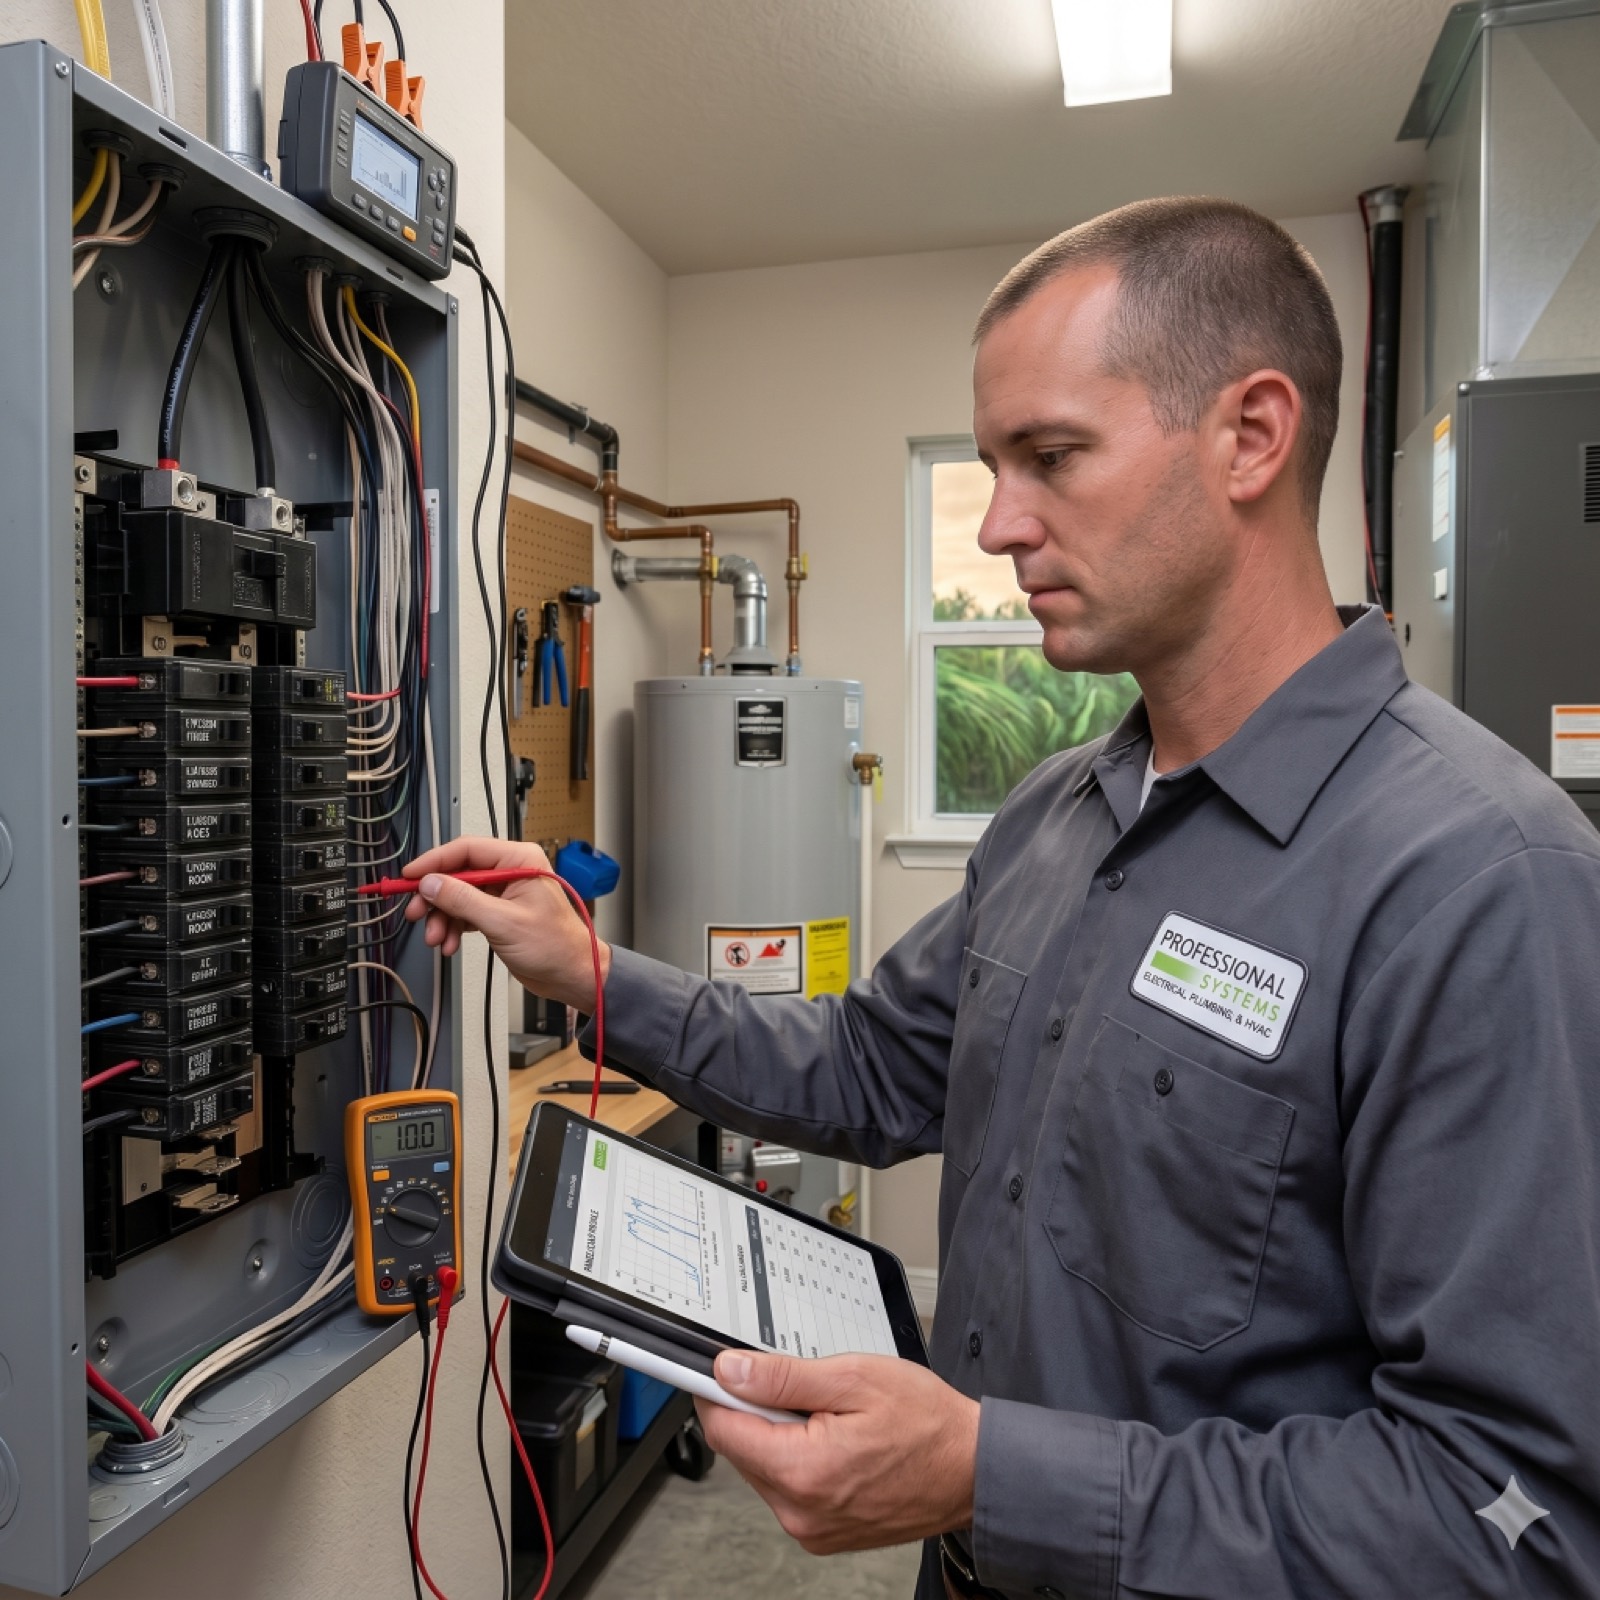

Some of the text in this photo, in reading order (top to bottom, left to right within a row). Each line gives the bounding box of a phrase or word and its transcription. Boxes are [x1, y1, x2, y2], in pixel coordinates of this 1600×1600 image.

[1160, 929, 1286, 1000] PROFESSIONAL
[1199, 974, 1281, 1022] SYSTEMS
[1143, 971, 1187, 1000] ELECTRICAL,
[1235, 1013, 1243, 1025] &
[1244, 1018, 1273, 1039] HVAC
